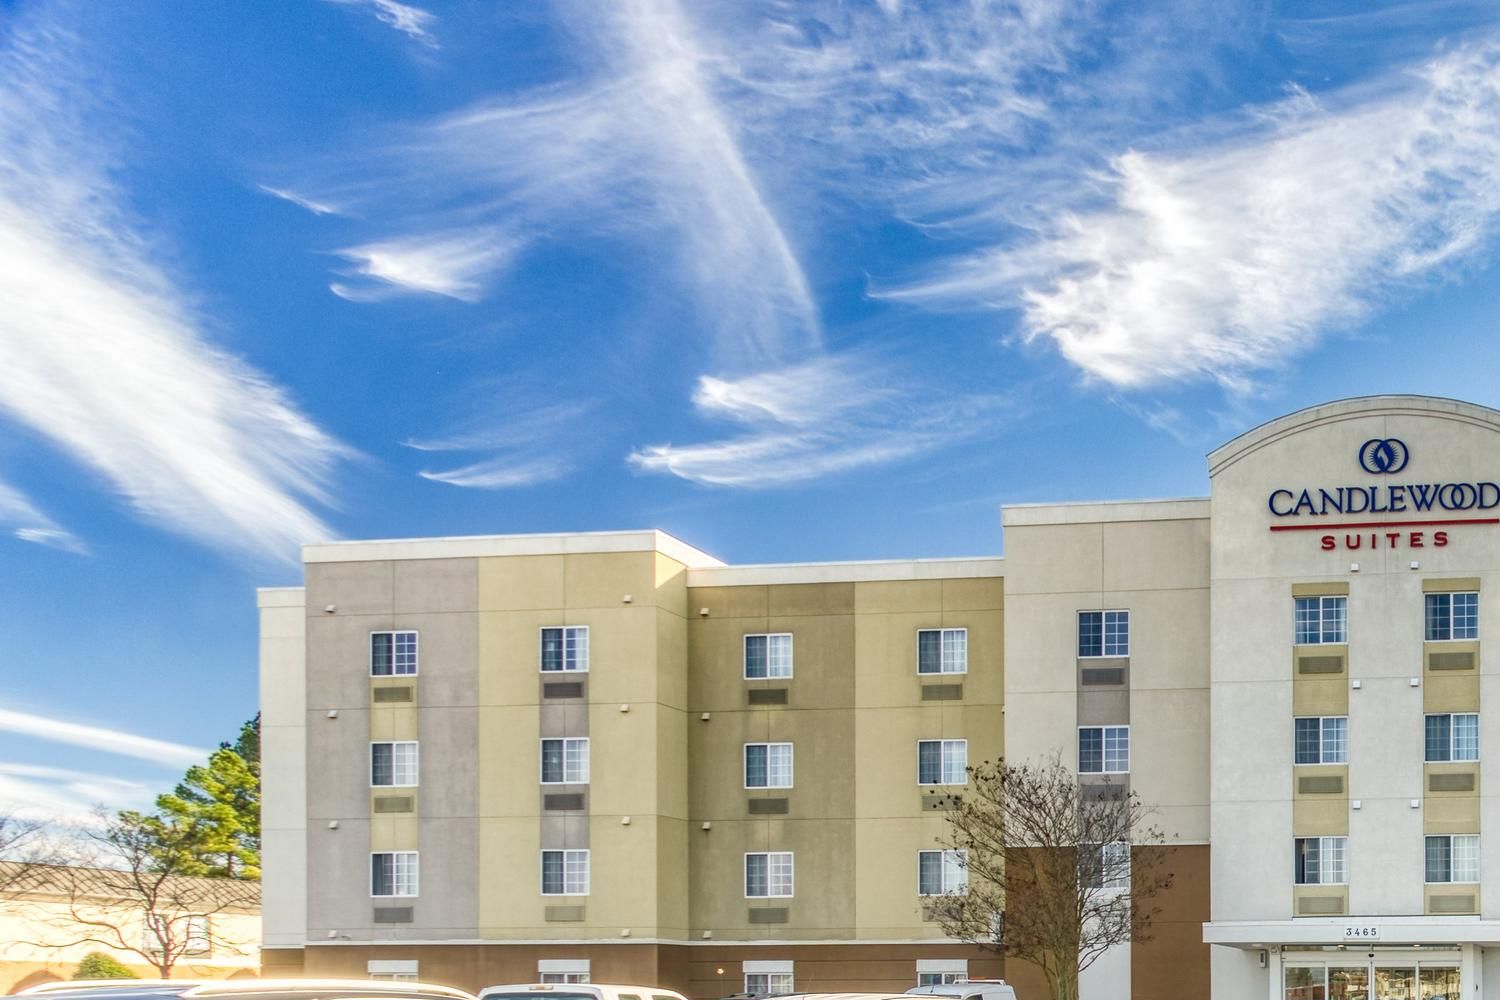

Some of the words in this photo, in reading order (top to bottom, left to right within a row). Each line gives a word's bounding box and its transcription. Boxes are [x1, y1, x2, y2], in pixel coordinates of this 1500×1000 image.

[1268, 482, 1500, 517] CANDLEWOOD
[1321, 532, 1448, 550] SUITES
[1346, 928, 1377, 936] 3465
